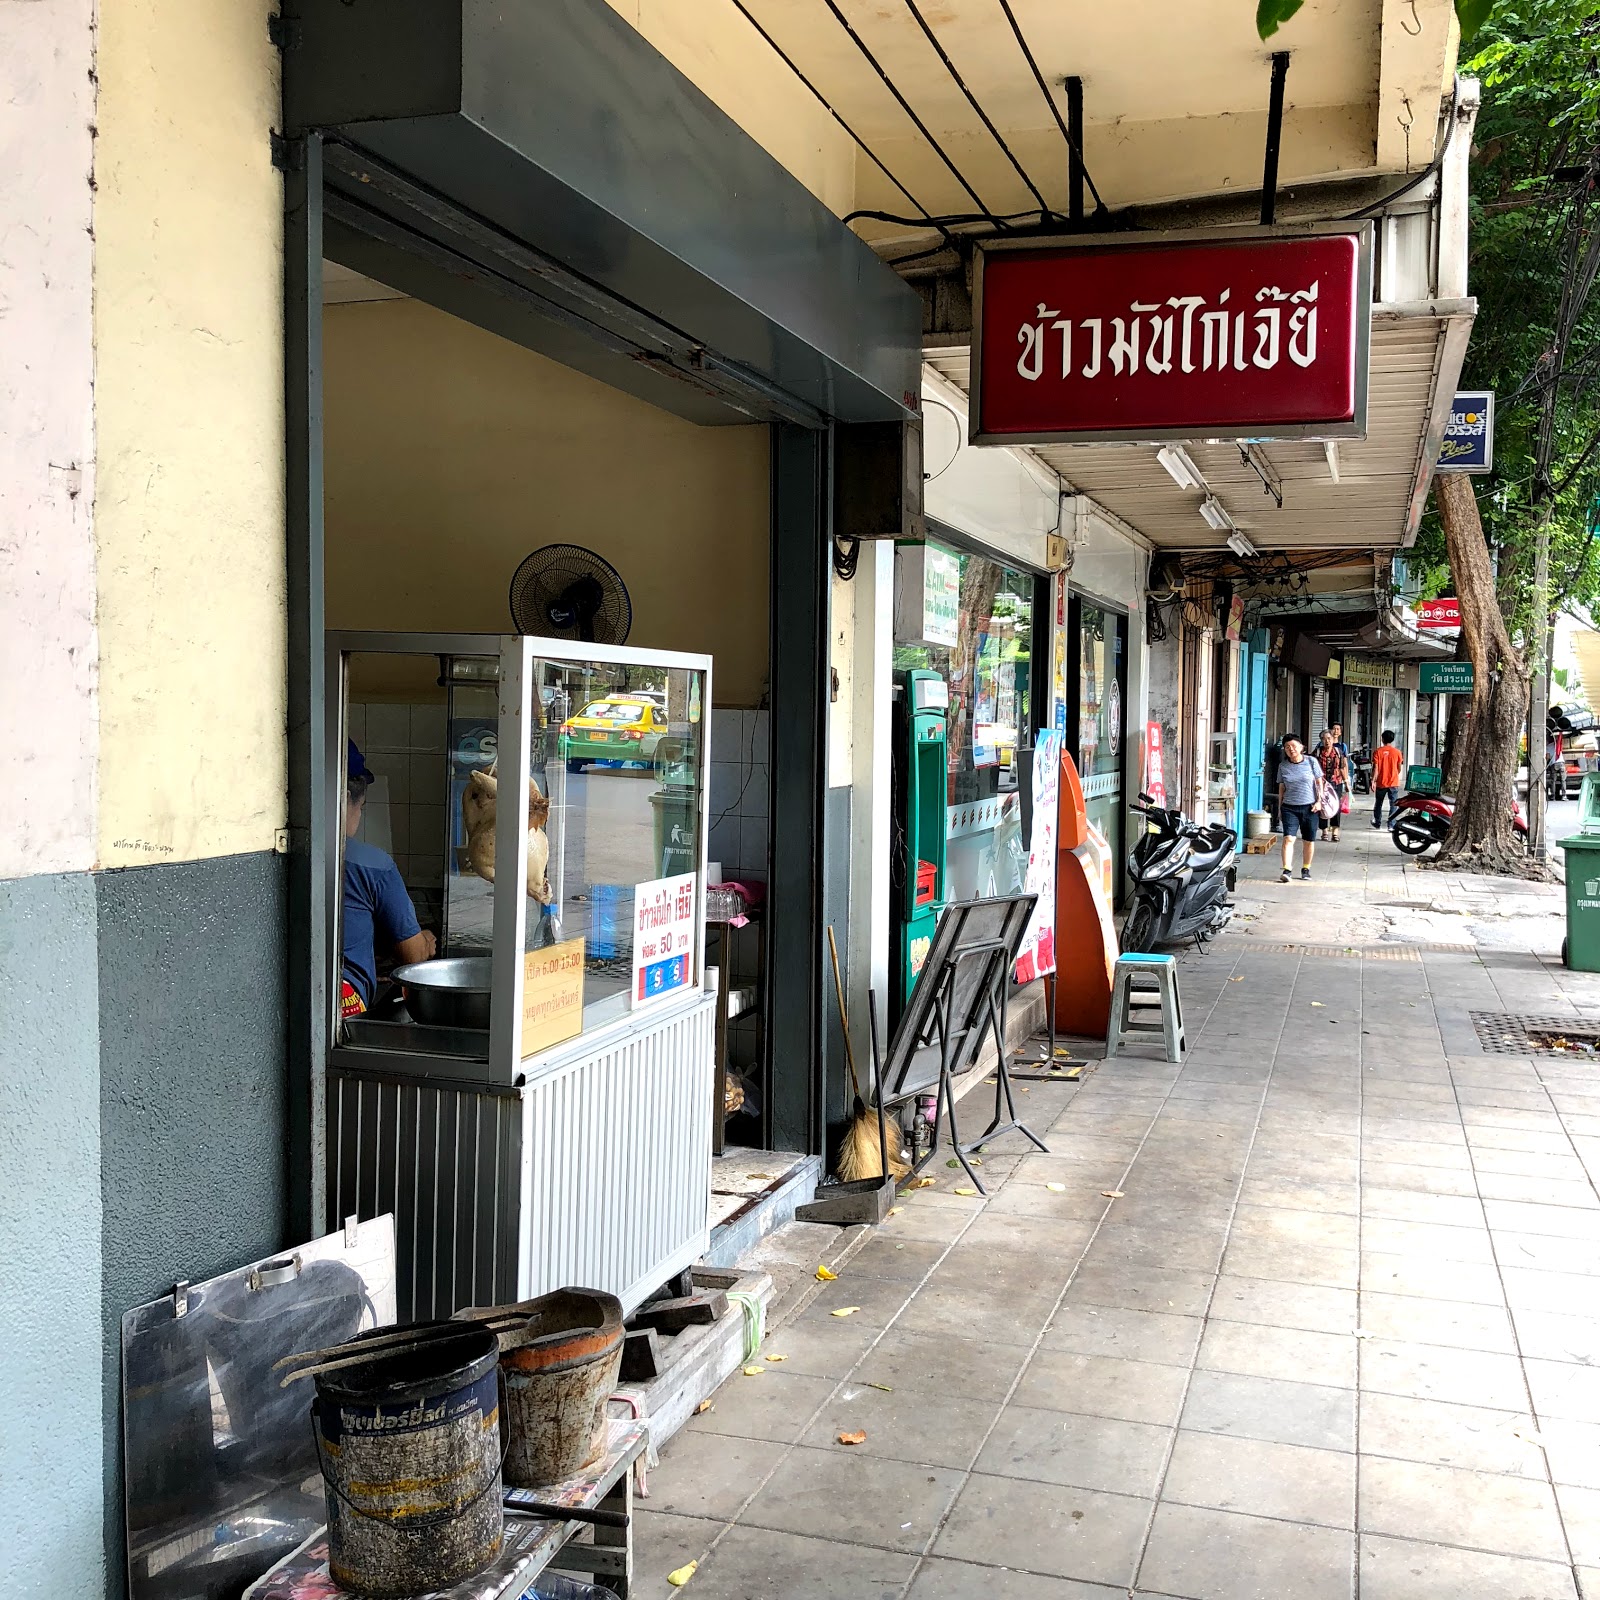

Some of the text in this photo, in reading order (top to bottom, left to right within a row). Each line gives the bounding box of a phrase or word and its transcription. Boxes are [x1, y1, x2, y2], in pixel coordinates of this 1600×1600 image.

[1016, 280, 1319, 381] ข้าวมันไก่เจ๊ยี
[638, 889, 672, 931] ข้าวมันไก่
[660, 932, 673, 954] 50
